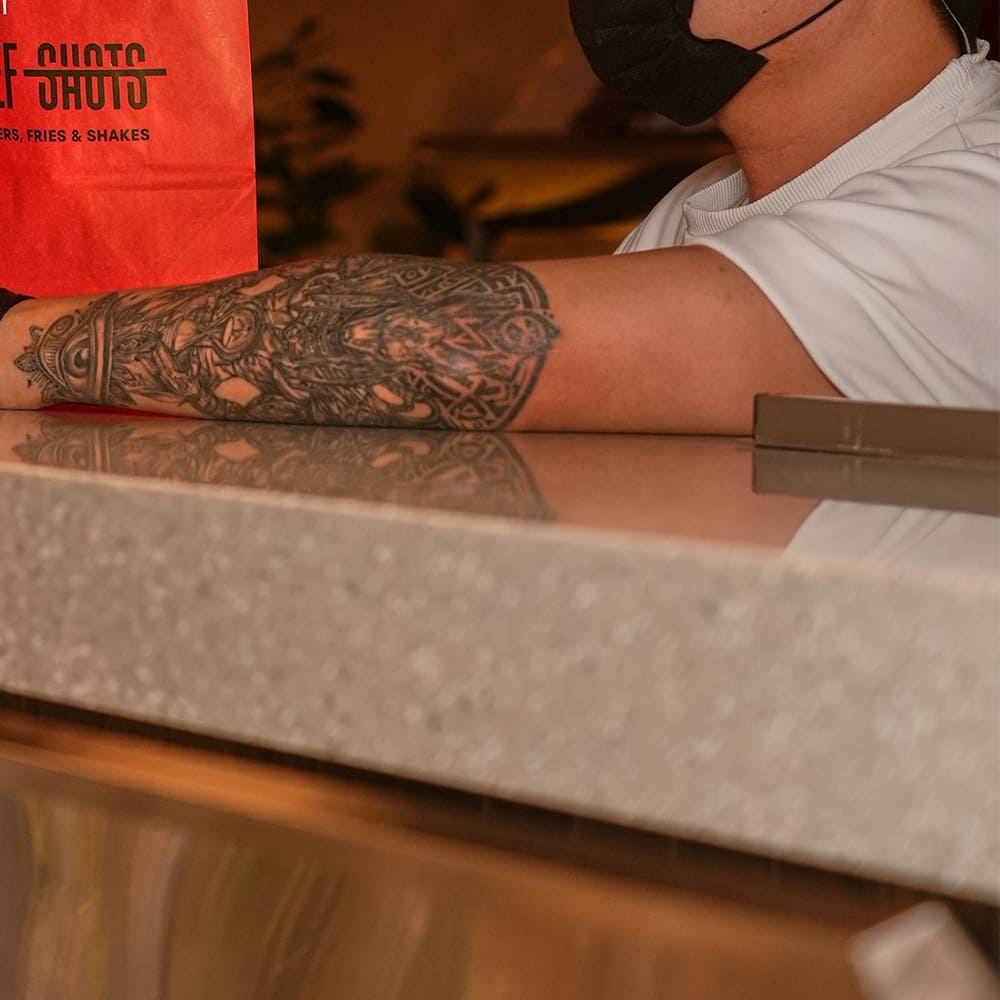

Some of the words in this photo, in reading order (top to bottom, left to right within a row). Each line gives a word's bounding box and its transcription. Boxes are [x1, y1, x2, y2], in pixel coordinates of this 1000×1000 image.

[25, 43, 166, 111] SHOTS
[27, 129, 66, 142] FRIES
[71, 129, 82, 142] &
[87, 128, 150, 142] SHAKES
